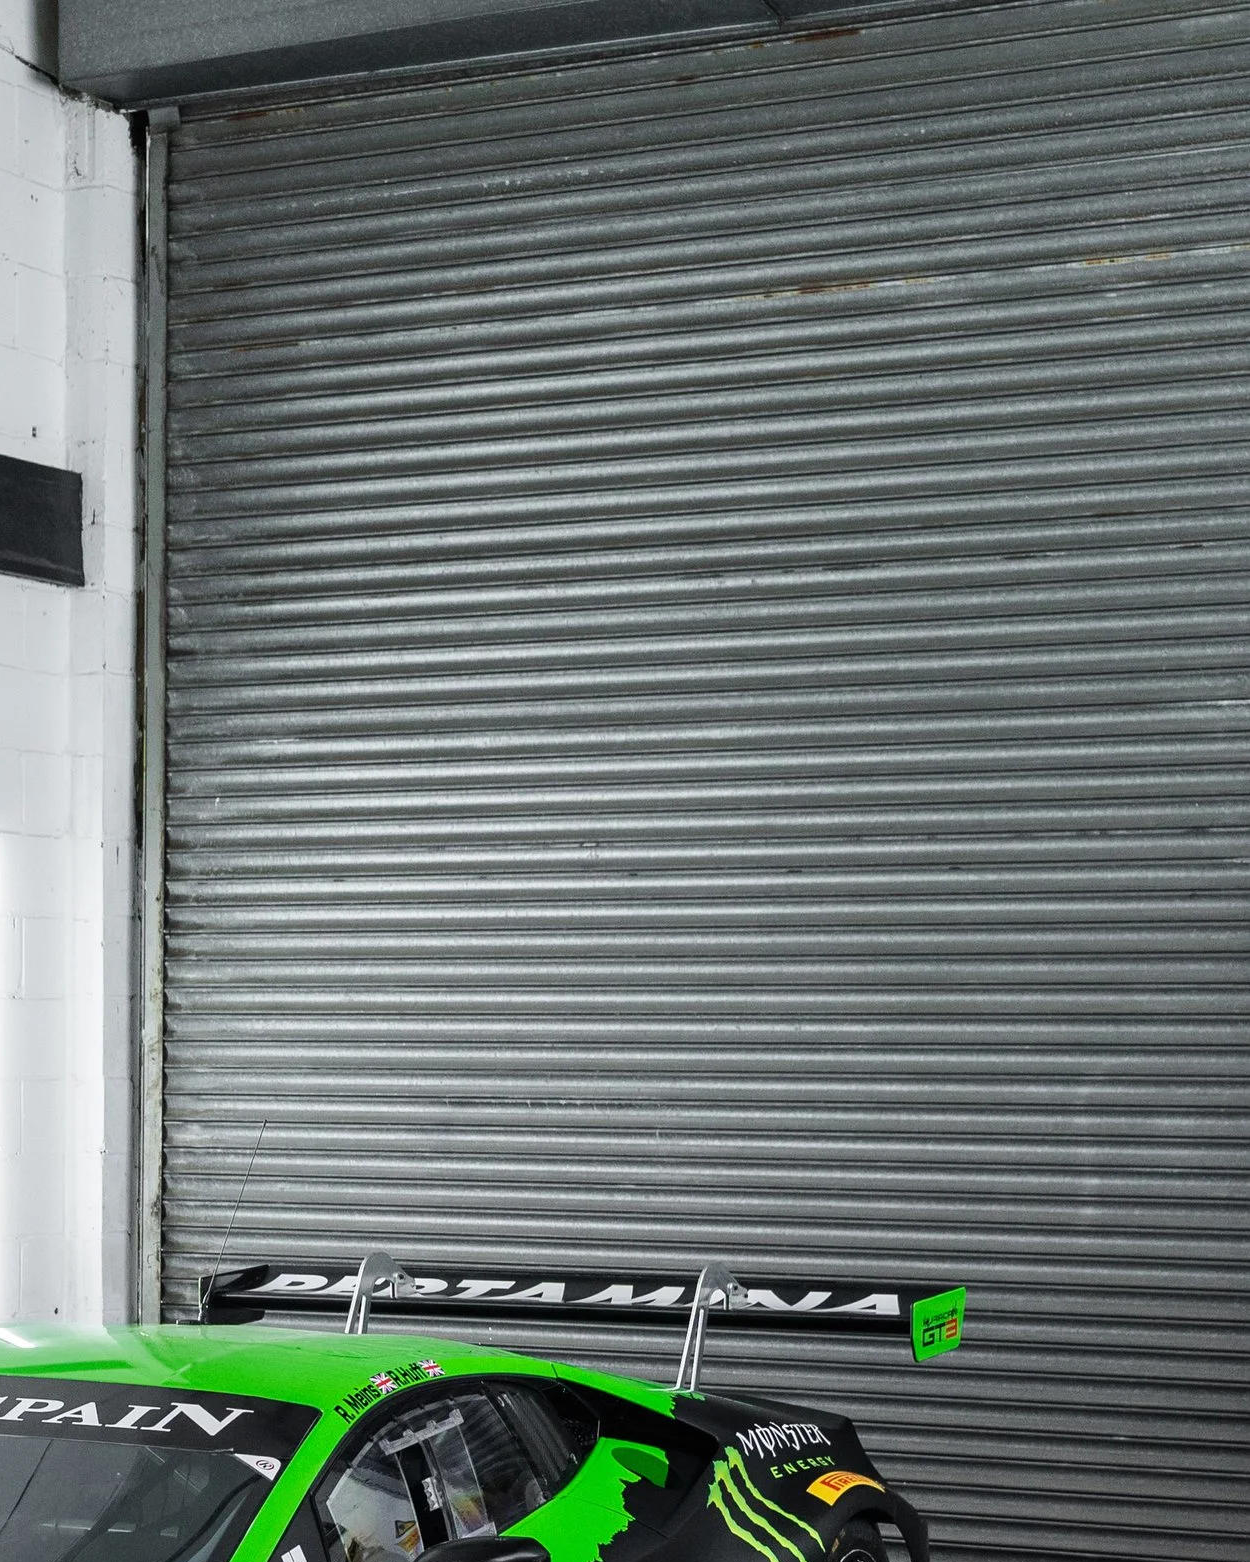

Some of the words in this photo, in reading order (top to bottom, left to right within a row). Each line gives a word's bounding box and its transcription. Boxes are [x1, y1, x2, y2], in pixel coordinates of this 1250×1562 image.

[923, 1317, 958, 1347] GT3
[343, 1384, 382, 1415] Meins
[770, 1455, 836, 1479] ENERGY
